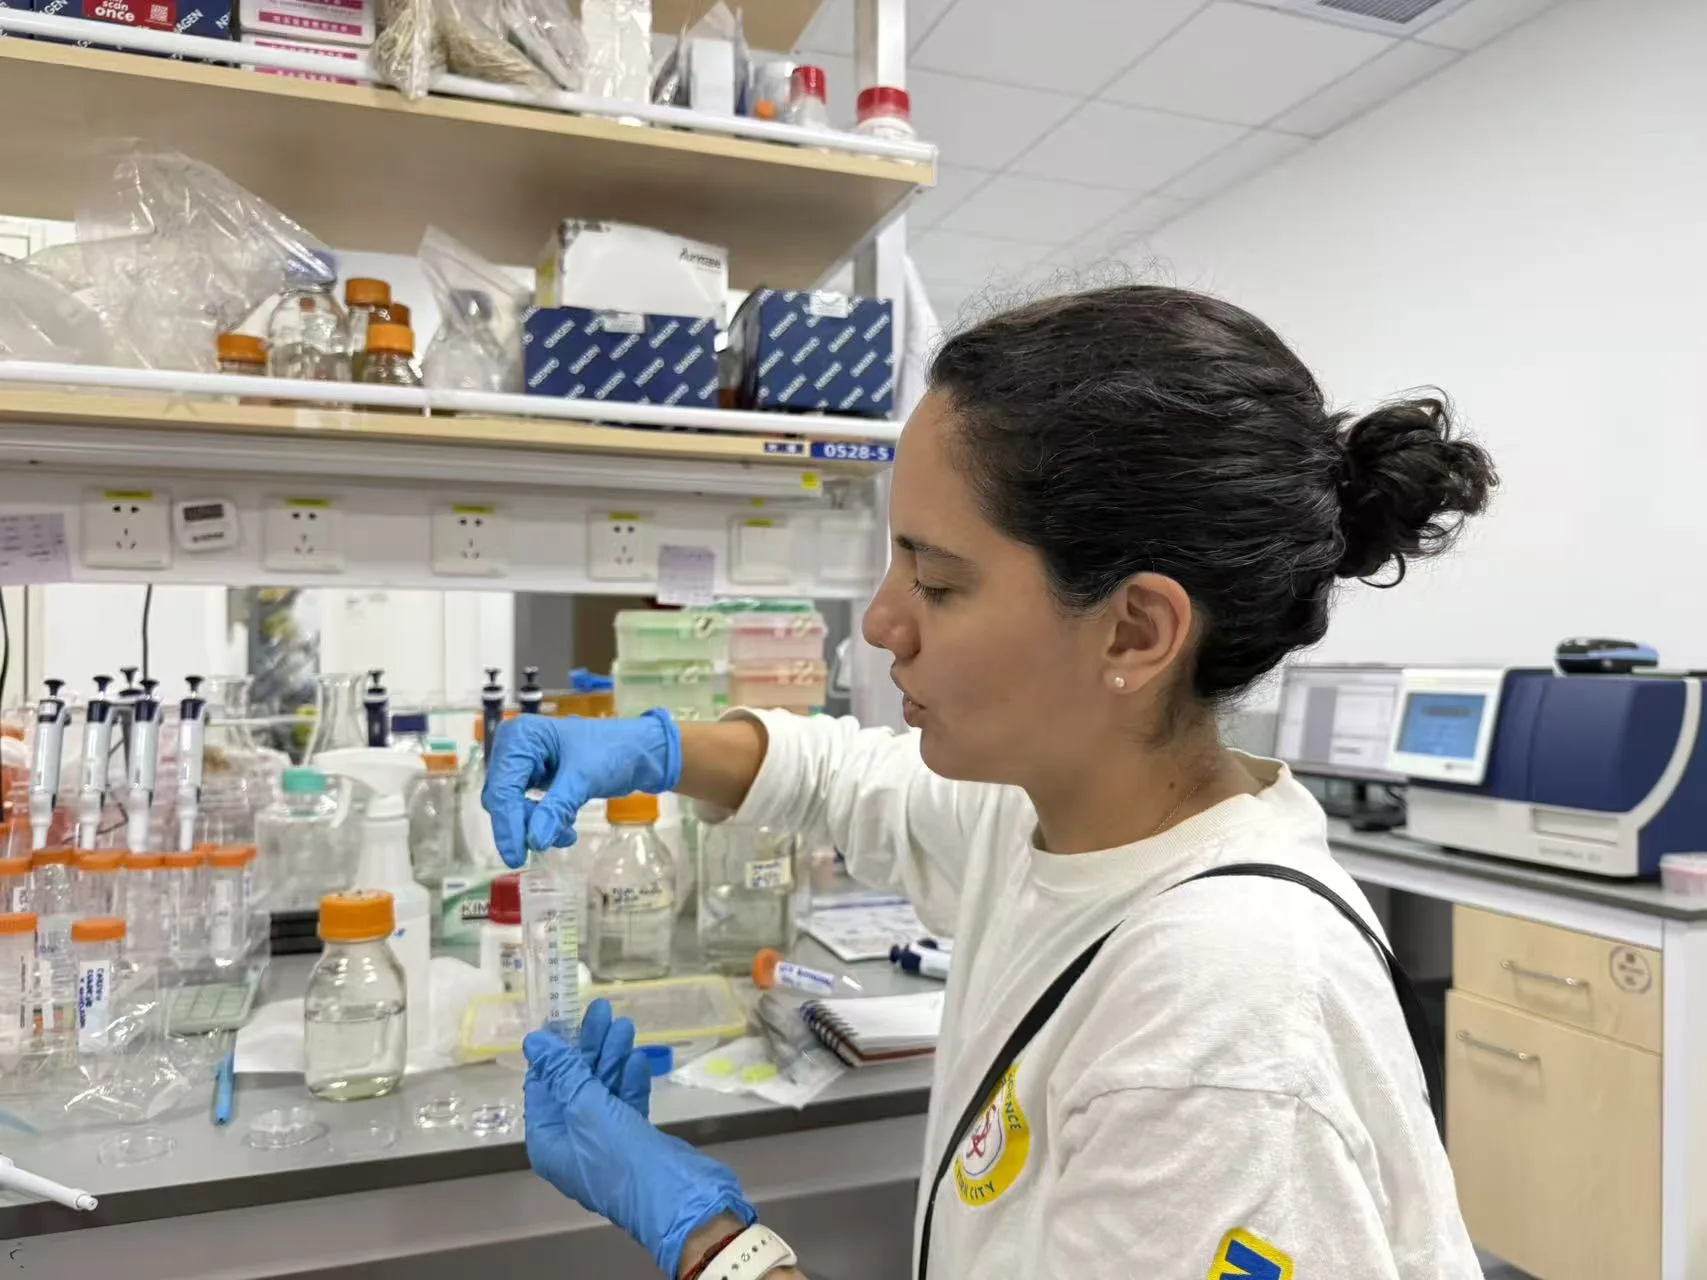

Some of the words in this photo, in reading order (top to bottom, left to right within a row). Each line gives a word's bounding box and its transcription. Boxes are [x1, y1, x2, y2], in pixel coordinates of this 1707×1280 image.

[95, 6, 135, 22] once
[176, 8, 204, 33] AGEN
[461, 902, 490, 916] KIM
[549, 991, 560, 1001] 20
[969, 1180, 996, 1201] CITY
